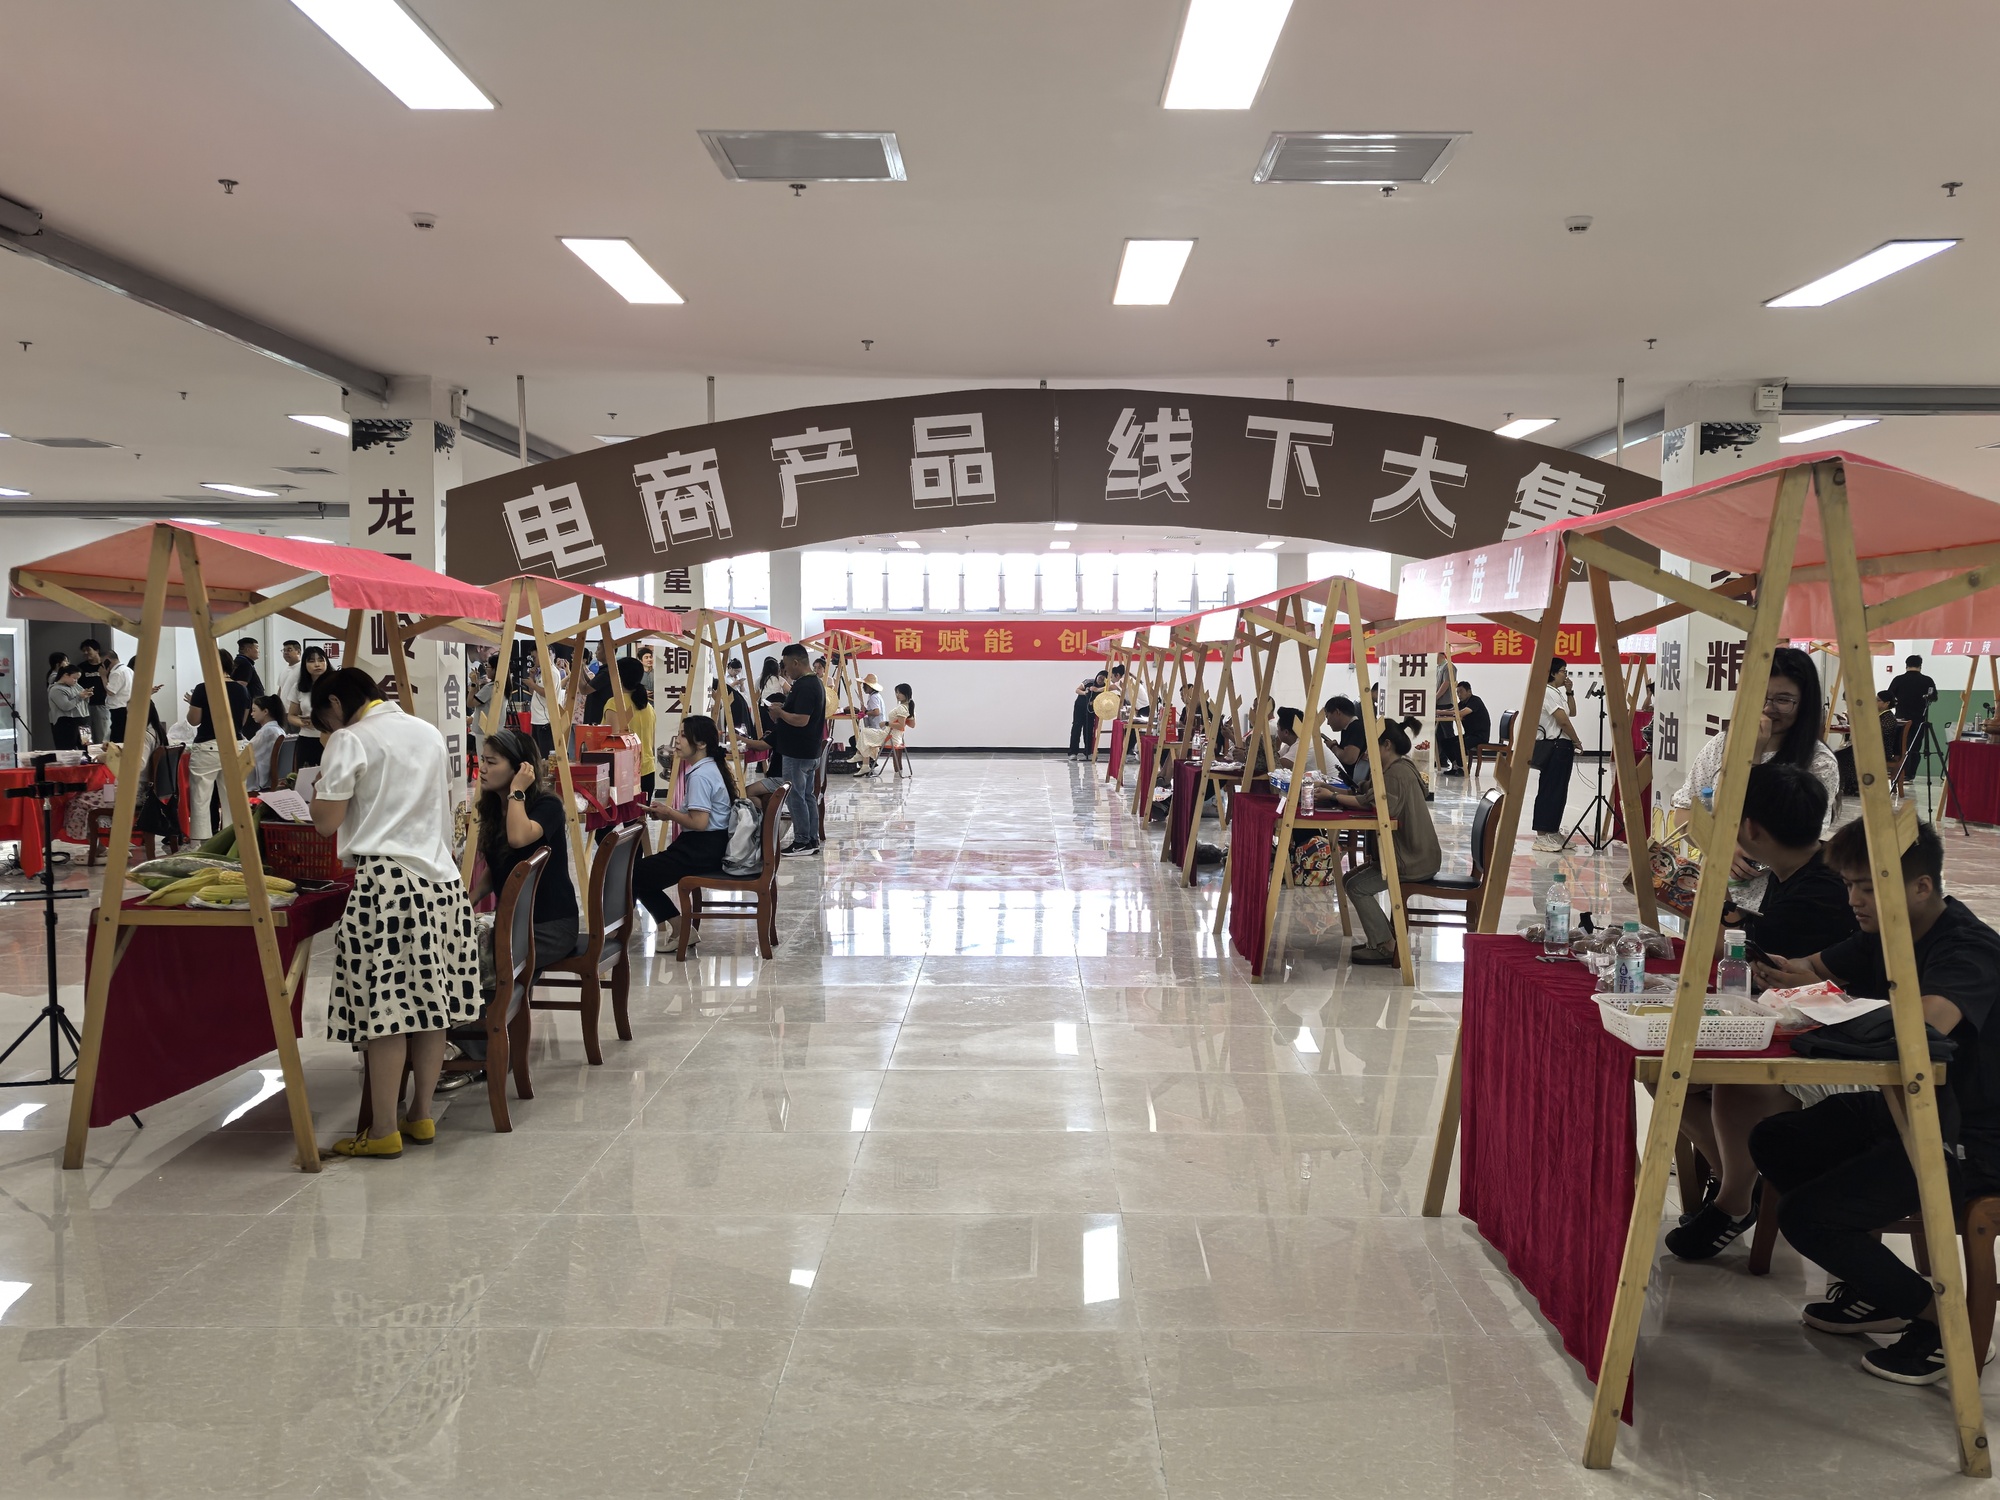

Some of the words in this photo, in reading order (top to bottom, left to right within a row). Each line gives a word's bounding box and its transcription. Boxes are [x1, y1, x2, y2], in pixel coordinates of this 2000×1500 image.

[664, 567, 692, 713] 星铜艺
[1399, 653, 1428, 717] 拼团
